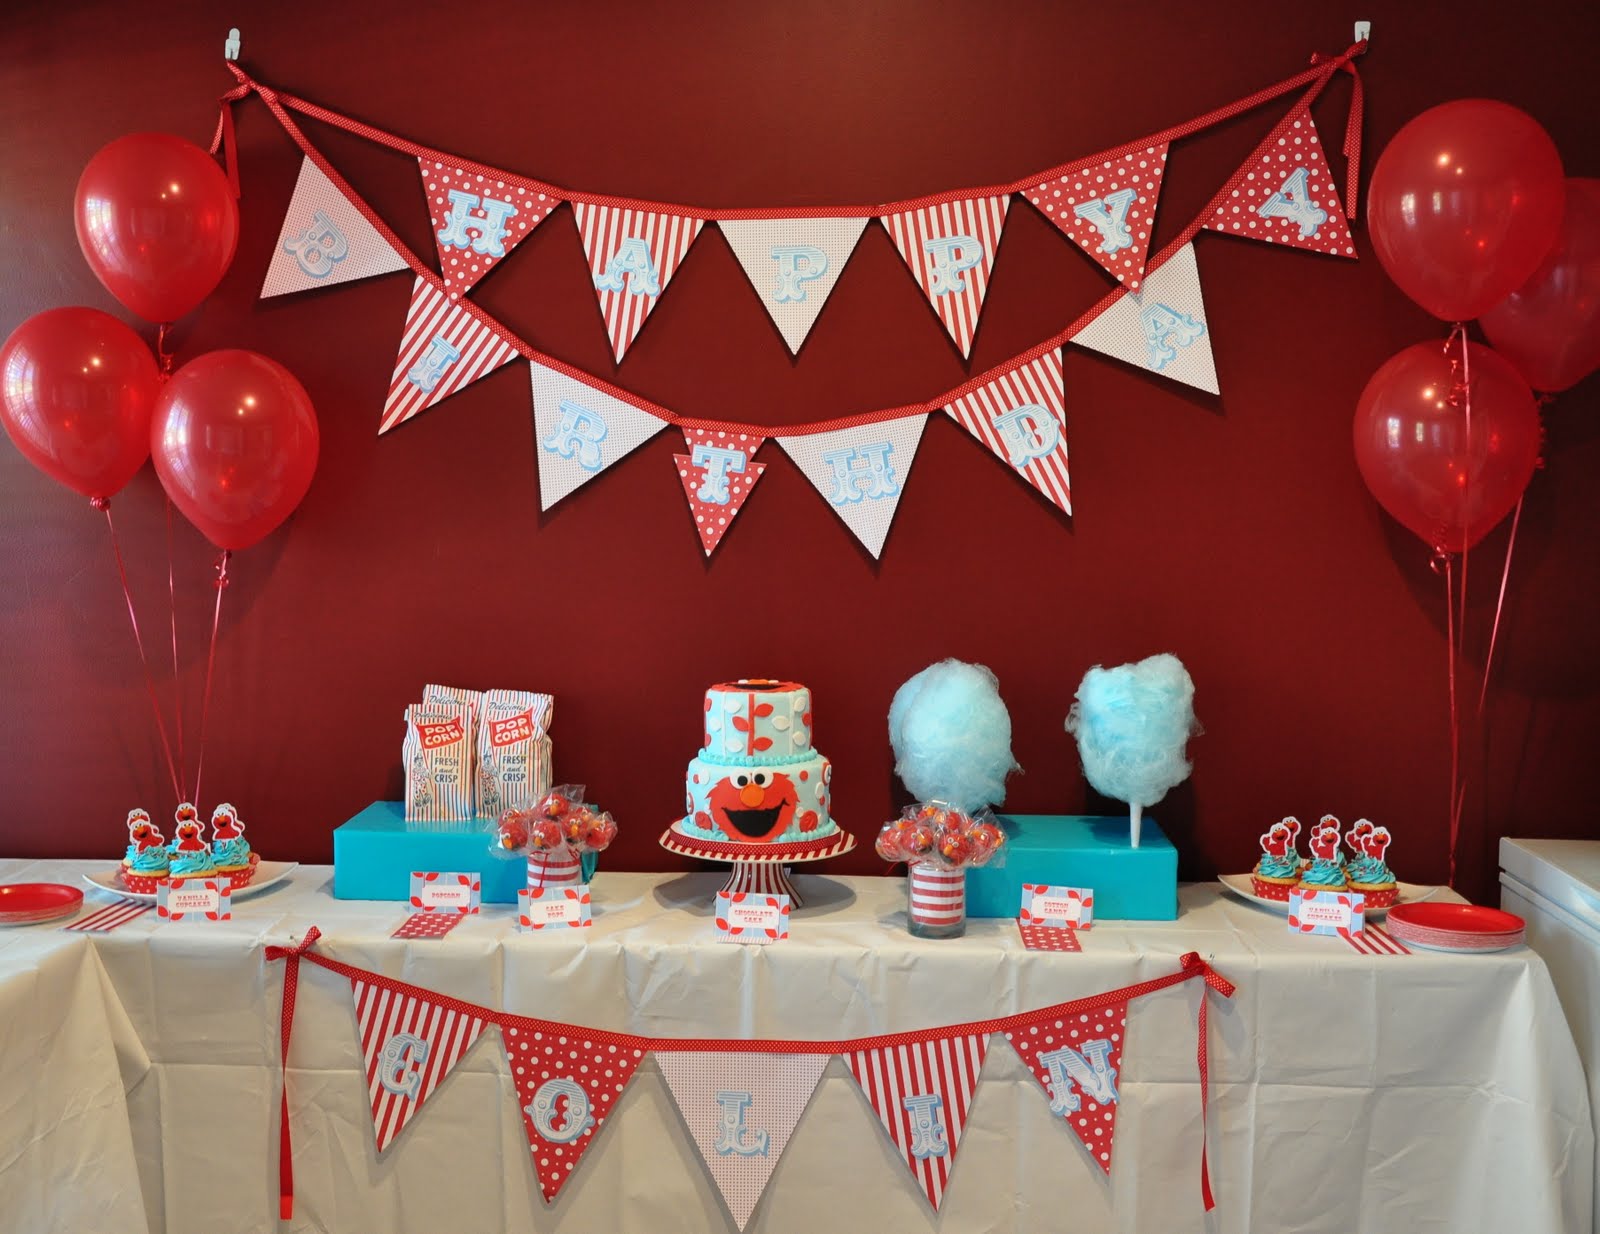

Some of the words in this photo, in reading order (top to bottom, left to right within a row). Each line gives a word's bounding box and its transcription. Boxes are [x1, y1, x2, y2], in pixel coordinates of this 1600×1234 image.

[424, 724, 456, 735] POP
[496, 717, 528, 733] POP
[424, 730, 460, 745] CORN
[494, 726, 530, 743] CORN
[434, 757, 459, 767] FRESH
[502, 755, 527, 765] FRESH
[438, 767, 455, 775] and
[434, 774, 458, 784] CRISP
[502, 773, 526, 783] CRISP
